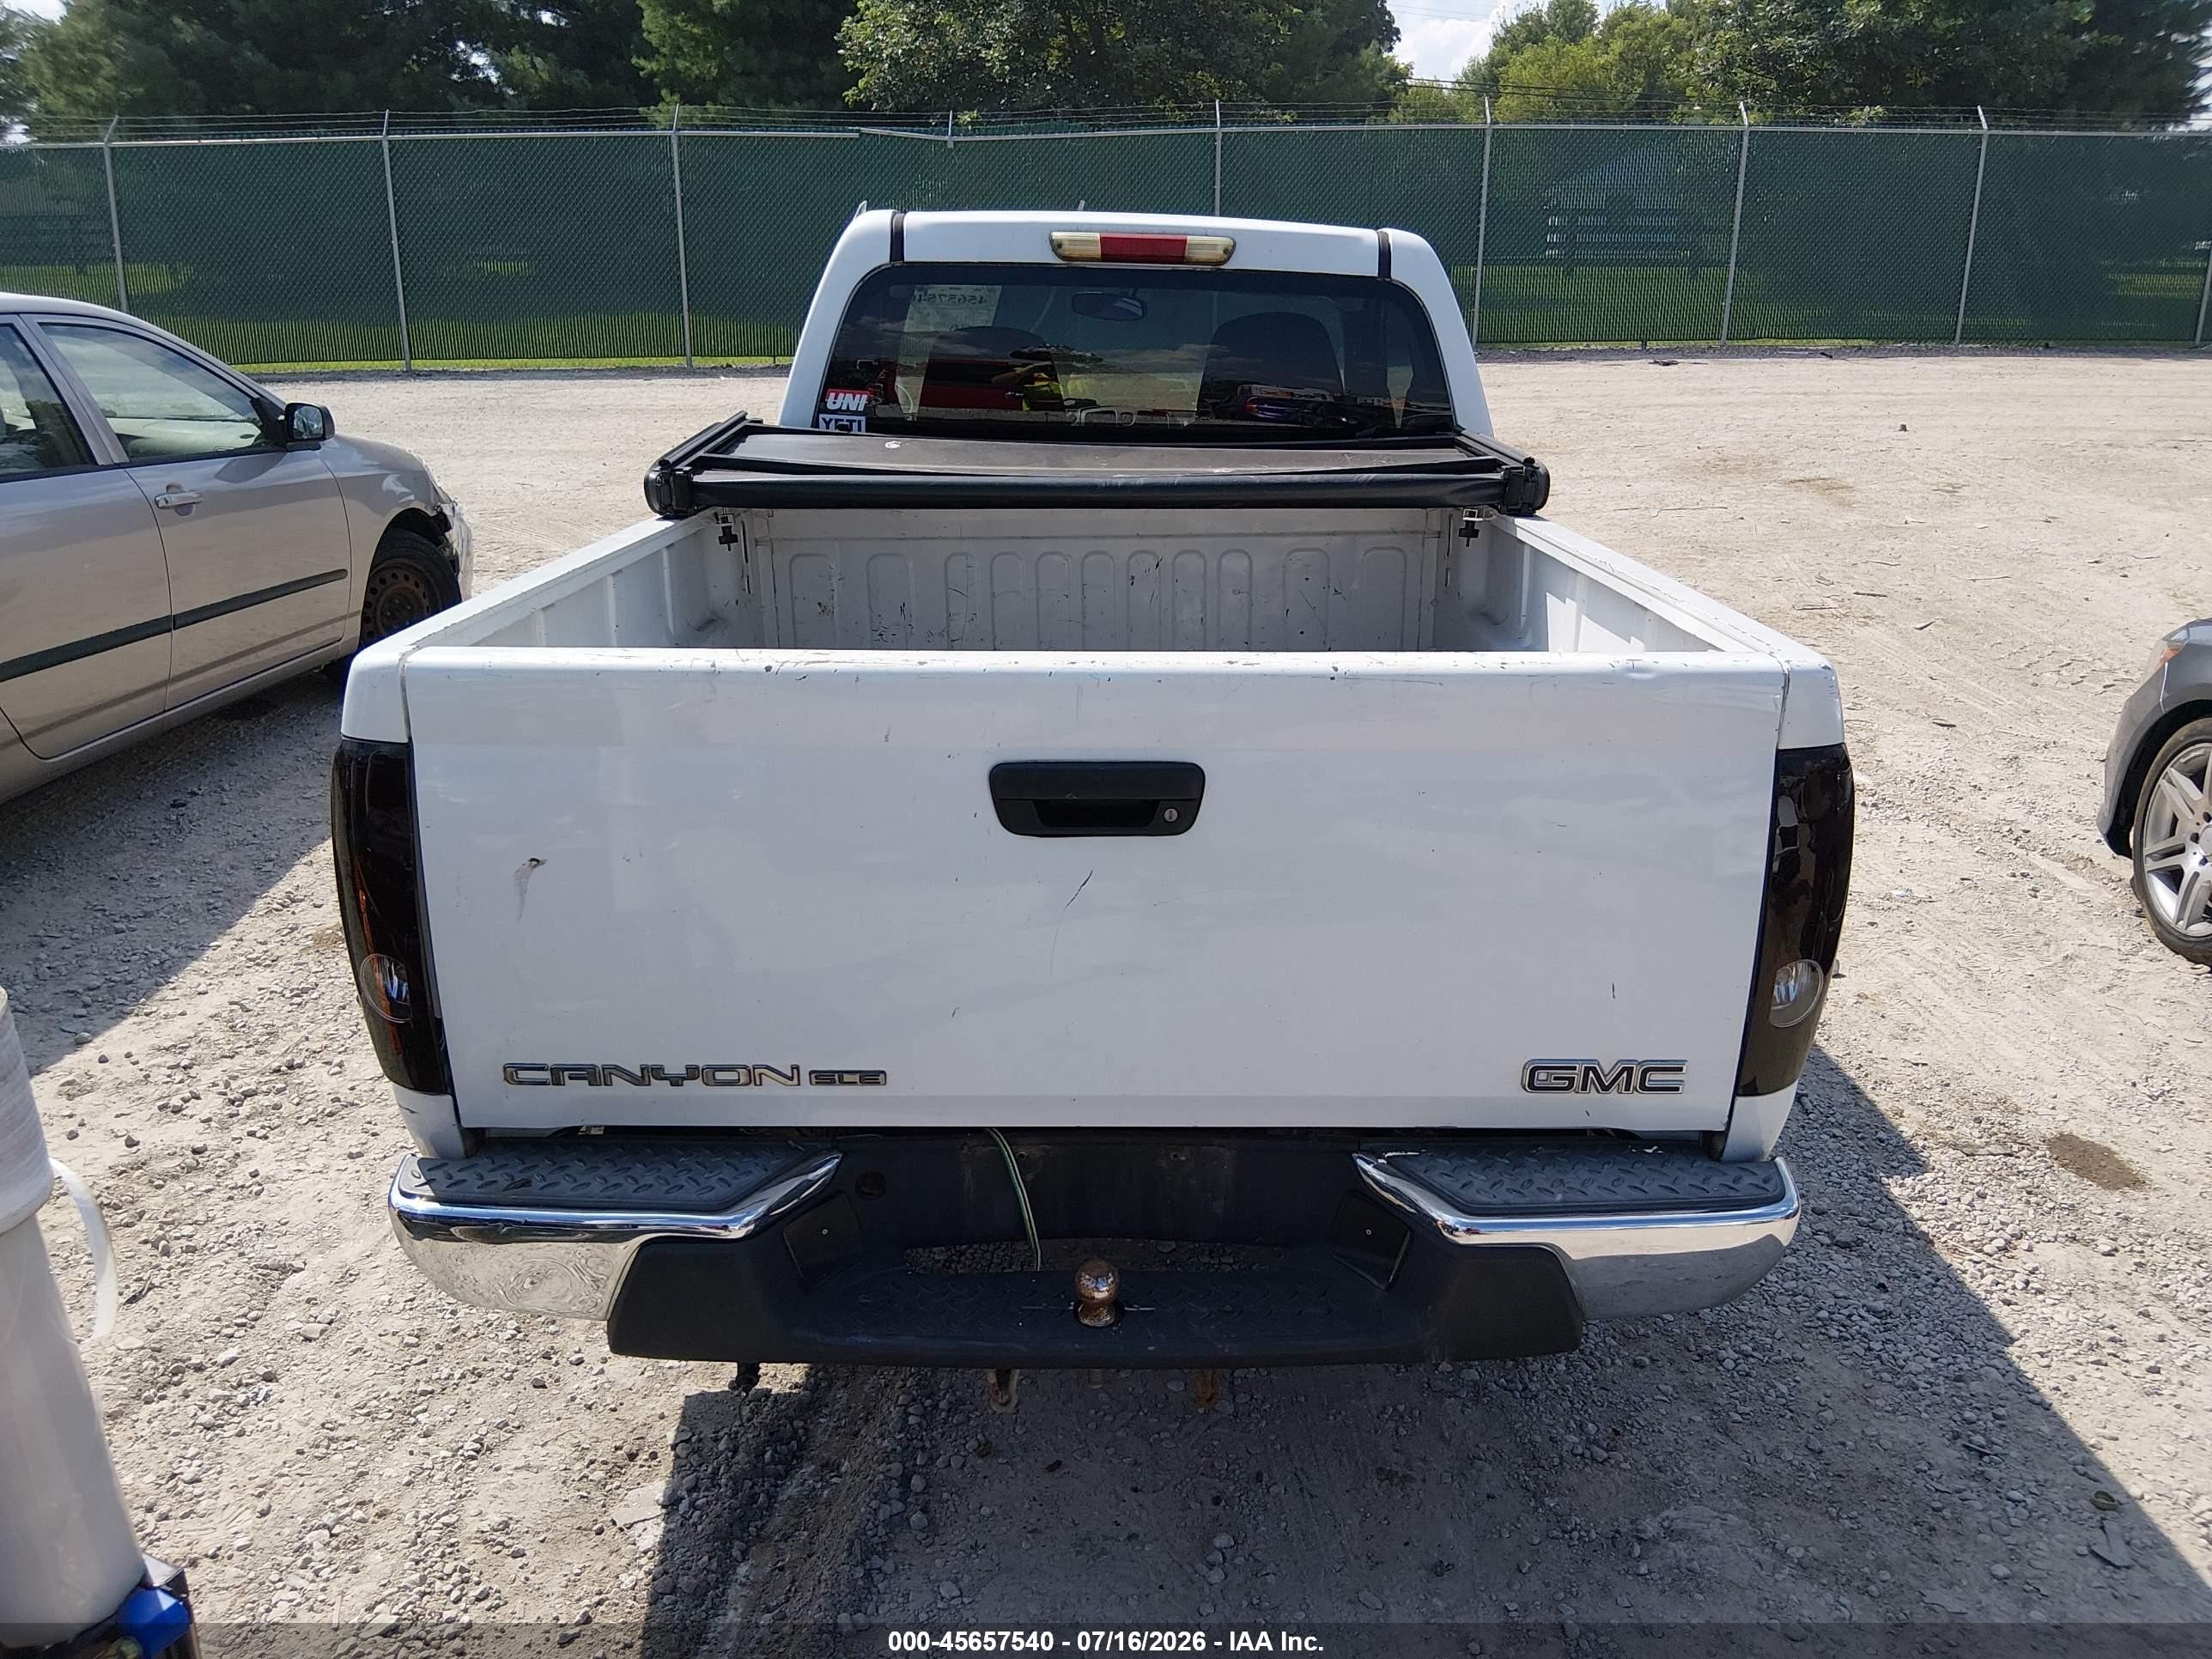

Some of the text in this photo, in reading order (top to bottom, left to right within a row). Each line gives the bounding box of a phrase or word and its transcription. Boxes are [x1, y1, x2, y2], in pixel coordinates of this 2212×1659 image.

[825, 392, 868, 411] UNI
[503, 1063, 884, 1086] CANYON SLE
[1522, 1059, 1687, 1094] GMC
